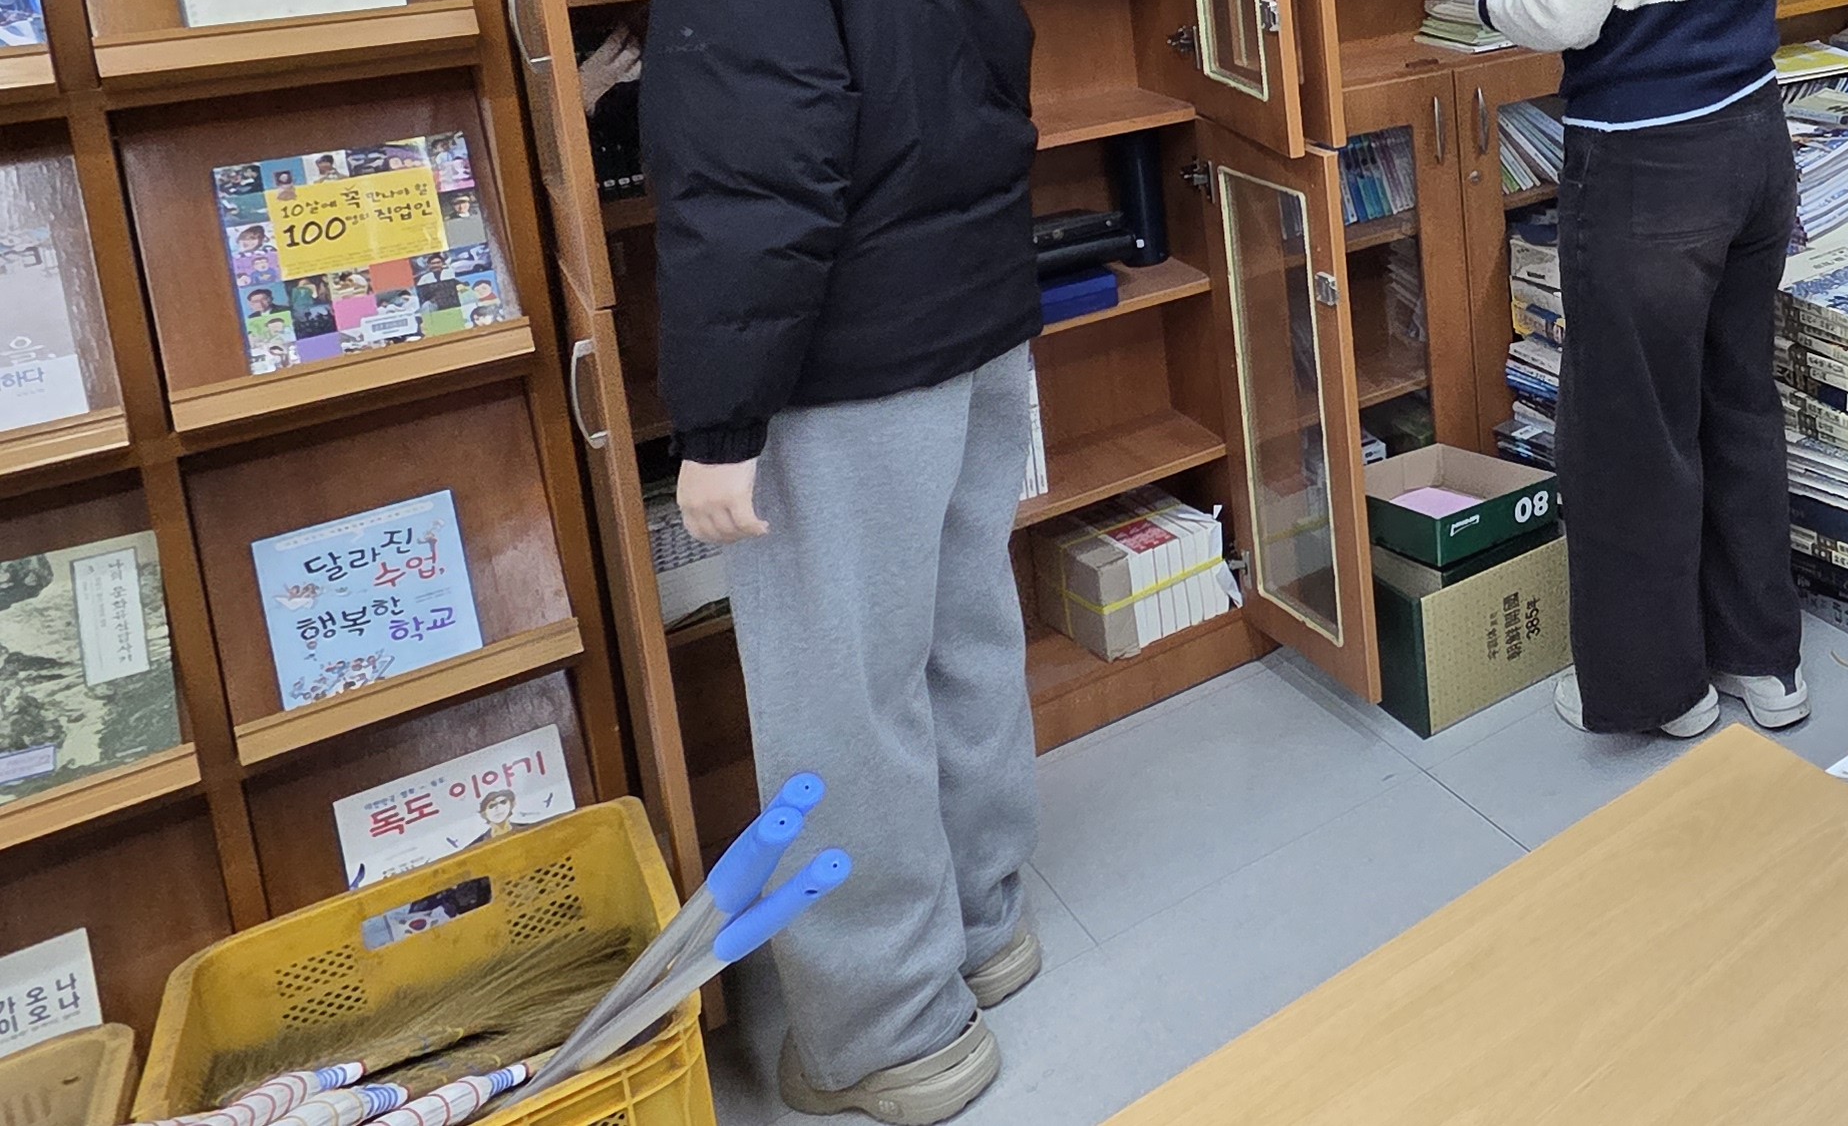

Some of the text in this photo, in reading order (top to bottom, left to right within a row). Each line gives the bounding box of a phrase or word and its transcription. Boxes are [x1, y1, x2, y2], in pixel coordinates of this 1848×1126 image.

[281, 200, 337, 219] 10살에
[340, 185, 360, 209] 꼭
[374, 201, 433, 223] 직업인
[303, 528, 413, 582] 달라진
[296, 596, 404, 640] 행복한
[389, 607, 456, 641] 학교
[369, 750, 546, 838] 독도 이야기
